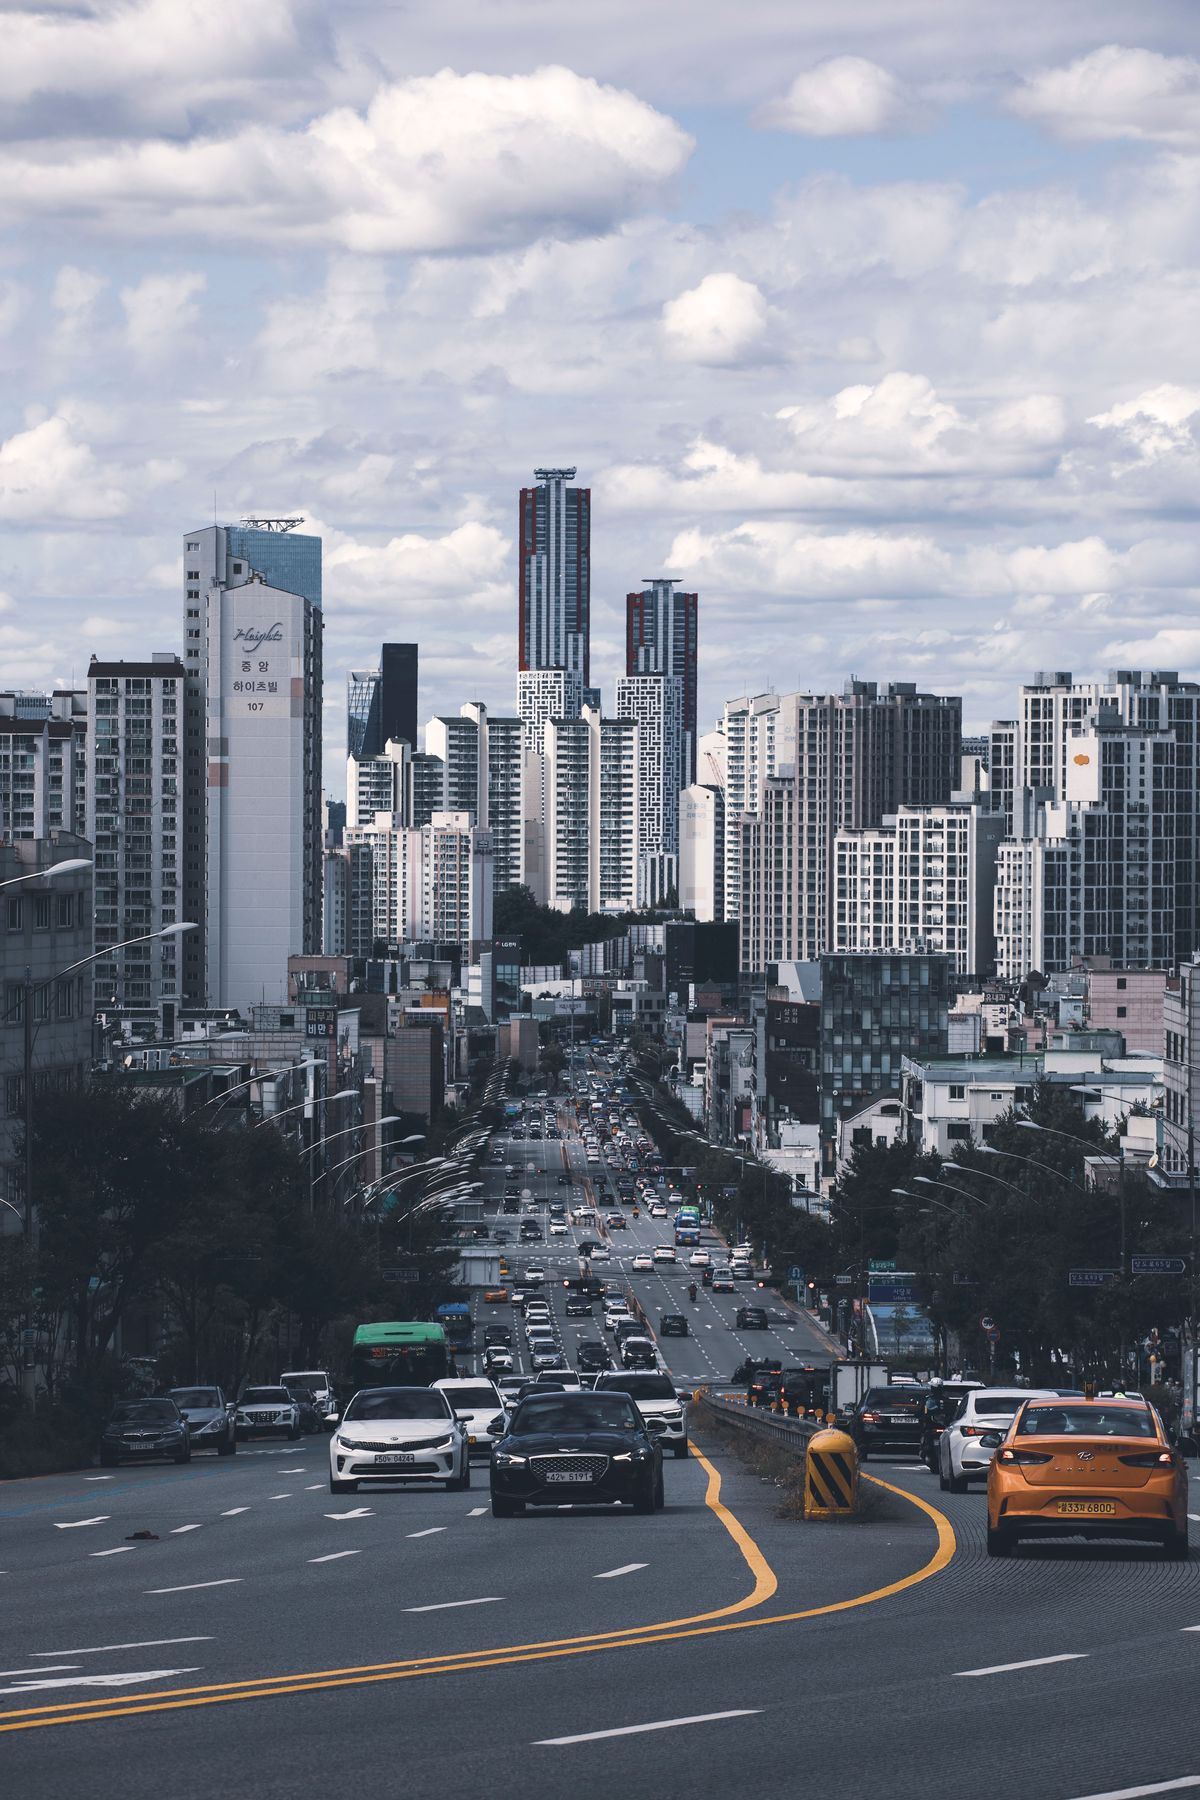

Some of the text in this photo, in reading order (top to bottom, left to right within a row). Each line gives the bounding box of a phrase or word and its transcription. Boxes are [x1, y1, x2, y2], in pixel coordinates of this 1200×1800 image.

[233, 681, 278, 692] 하이츠빌
[247, 703, 264, 711] 107
[308, 1010, 335, 1021] 피부과
[308, 1023, 326, 1035] 비만
[568, 1473, 588, 1481] 5191
[1087, 1503, 1112, 1512] 6800
